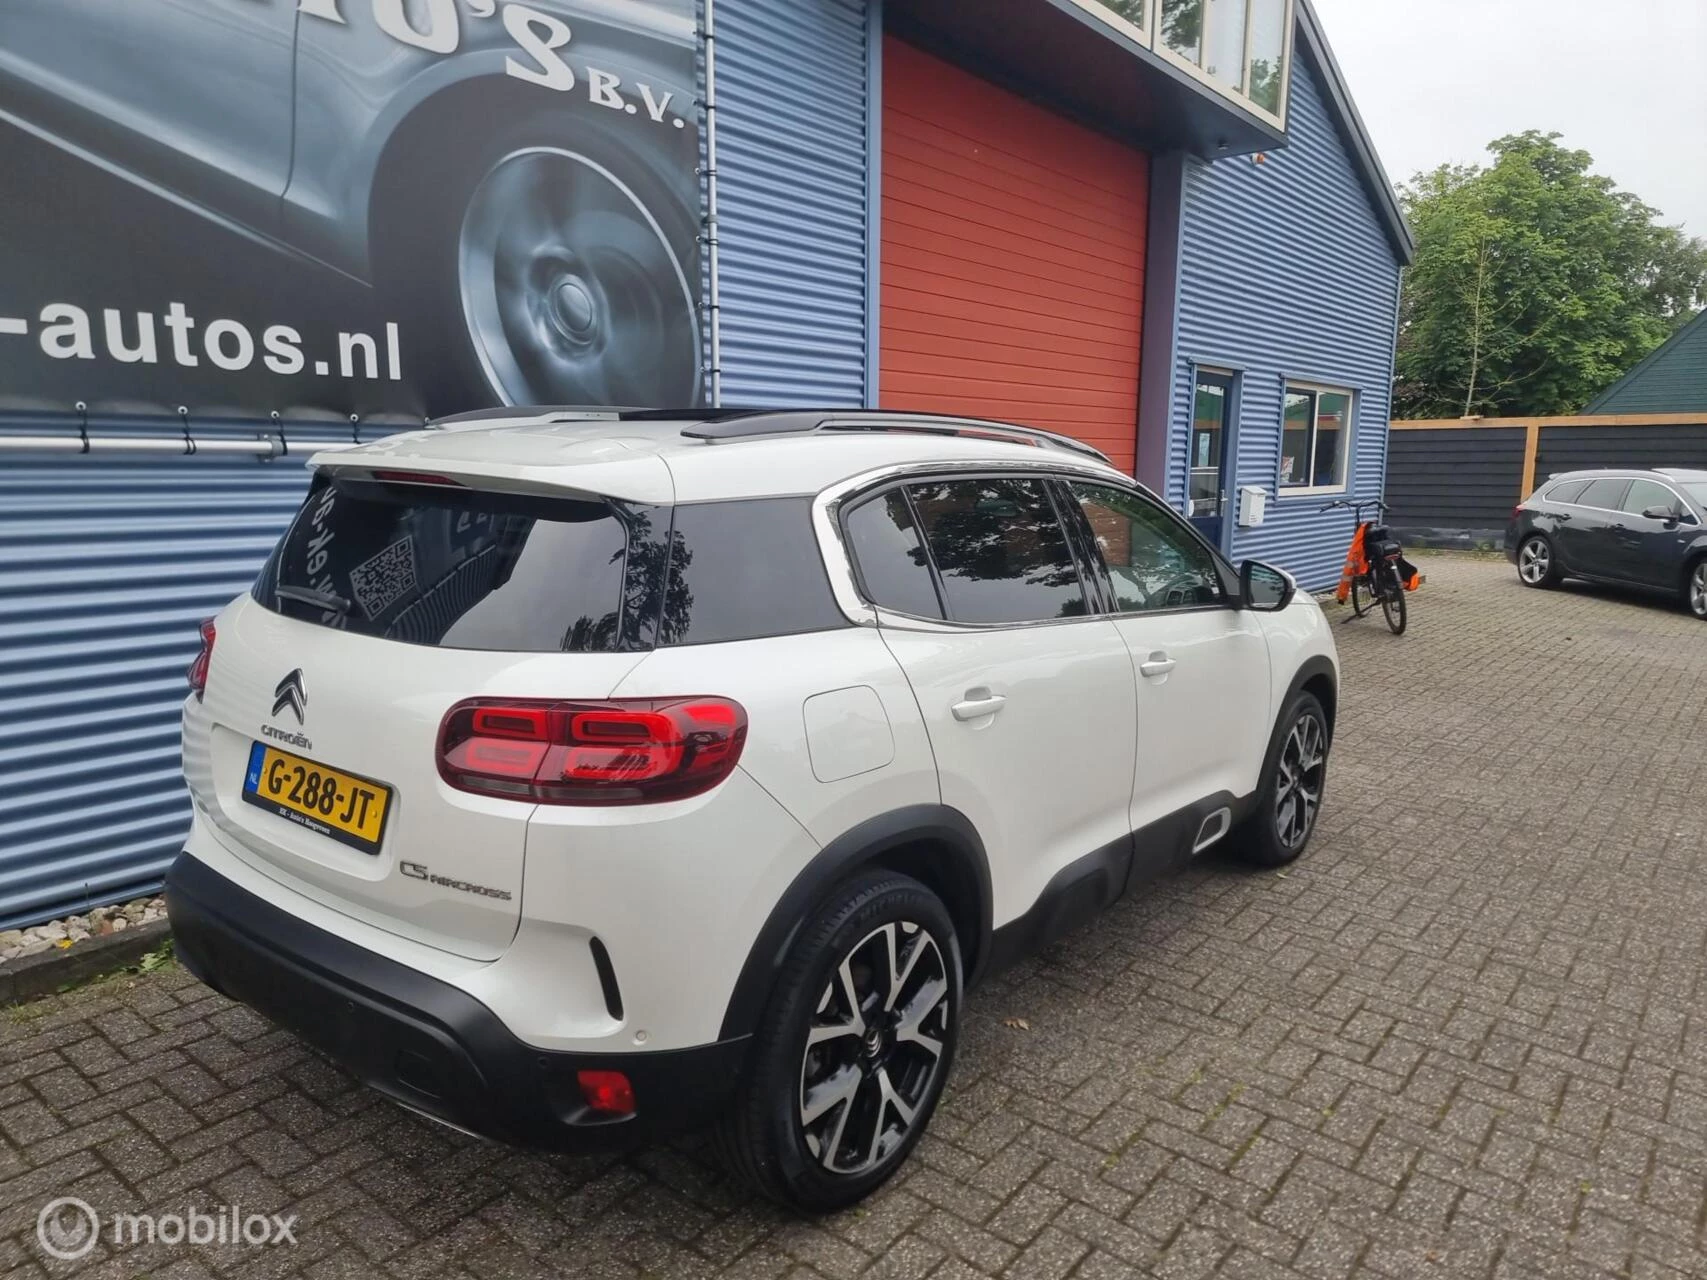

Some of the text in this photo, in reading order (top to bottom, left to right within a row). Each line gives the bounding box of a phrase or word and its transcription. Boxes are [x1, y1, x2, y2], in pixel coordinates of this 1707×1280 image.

[586, 66, 685, 129] B.V.
[261, 724, 312, 750] CITROËN
[268, 758, 375, 829] G-288-JT
[400, 861, 511, 900] C5 AIRCROSS
